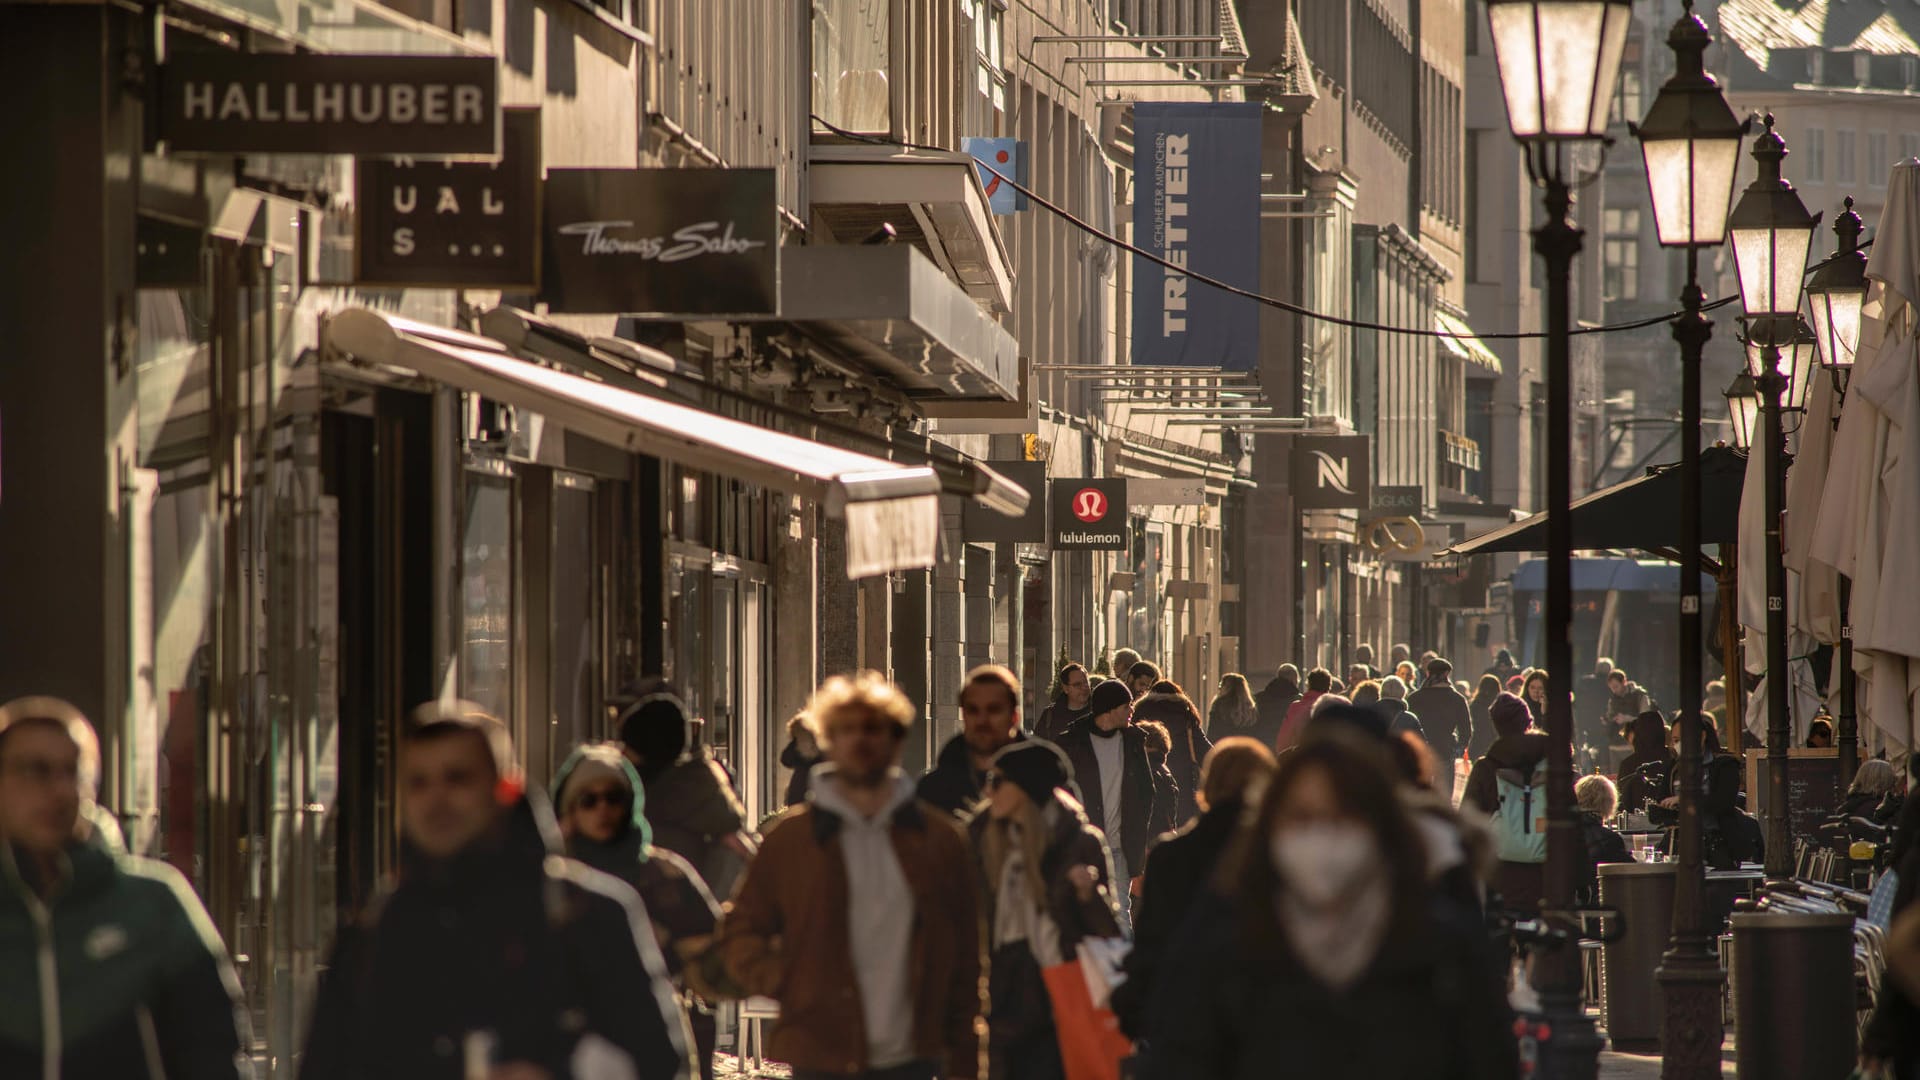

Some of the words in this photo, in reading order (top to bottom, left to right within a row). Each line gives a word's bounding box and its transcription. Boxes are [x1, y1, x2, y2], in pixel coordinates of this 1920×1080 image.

[183, 82, 484, 124] HALLHUBER
[557, 220, 664, 260] Thomas
[658, 220, 766, 262] Sabo
[1153, 206, 1165, 249] SCHUHE
[1163, 133, 1189, 338] TRETTER
[1059, 531, 1121, 544] lululemon
[1682, 598, 1698, 611] 21
[1769, 598, 1781, 610] 20
